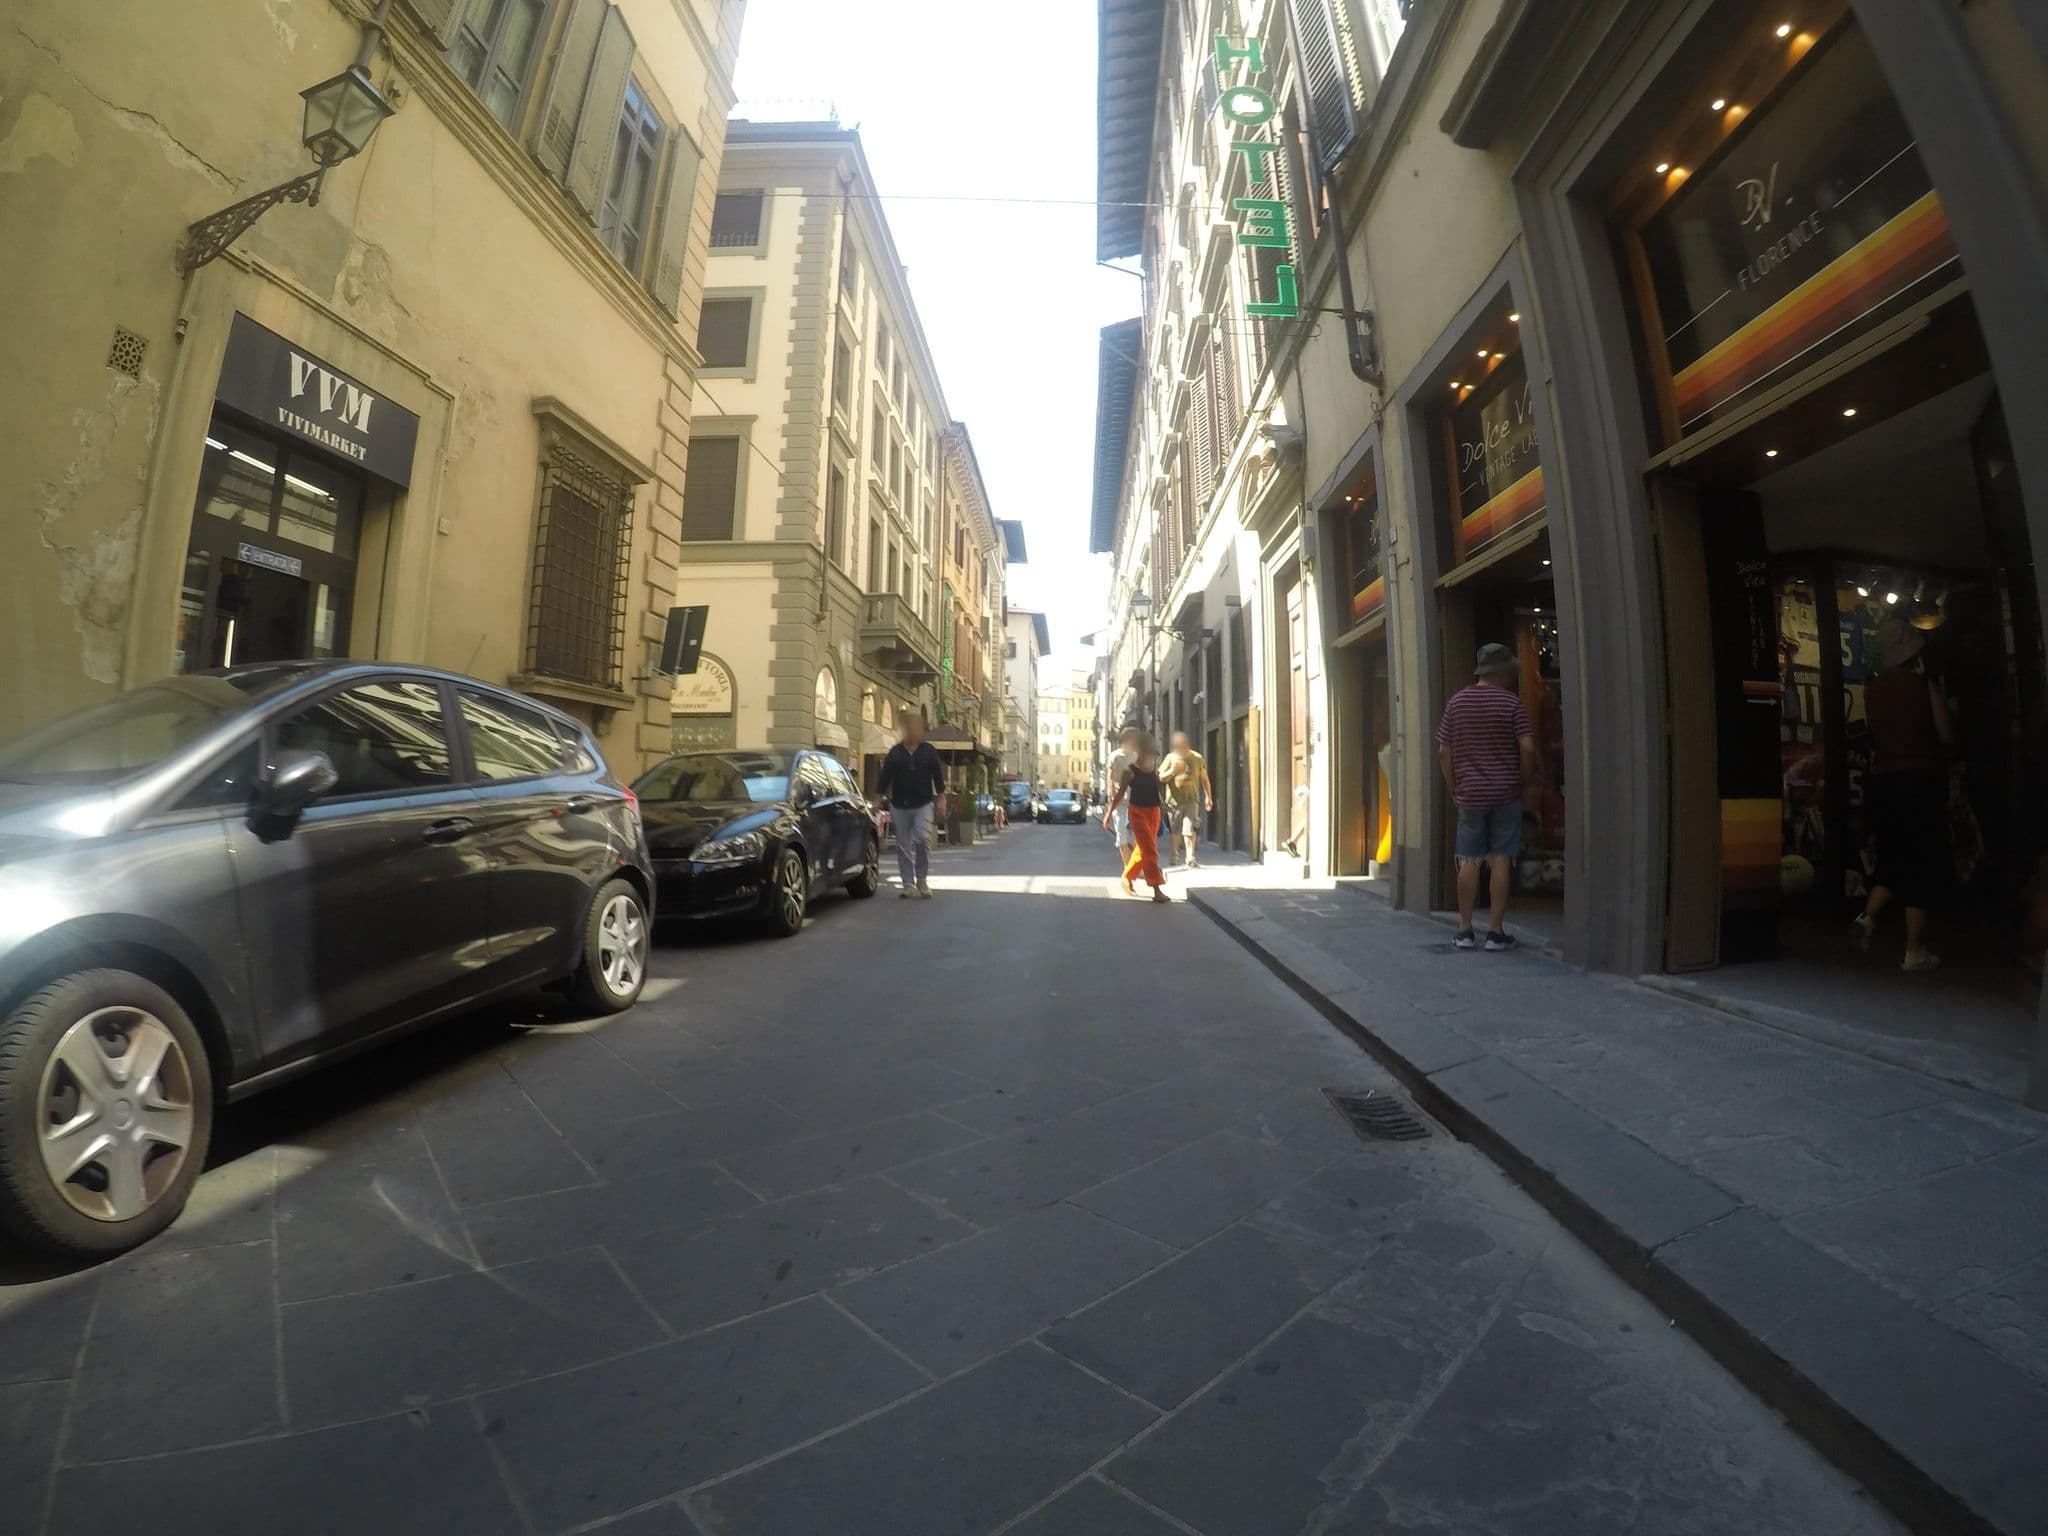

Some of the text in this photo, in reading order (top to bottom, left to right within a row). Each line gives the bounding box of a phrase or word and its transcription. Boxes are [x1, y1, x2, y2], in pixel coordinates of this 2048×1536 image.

[1737, 209, 1825, 291] FLORENCE
[289, 351, 374, 433] VVM
[276, 406, 367, 462] VIVIMARKET
[1462, 420, 1511, 473] Dolce
[1479, 446, 1517, 486] VINTAGE
[252, 552, 289, 570] ENTRATA
[698, 659, 729, 693] TTORIA
